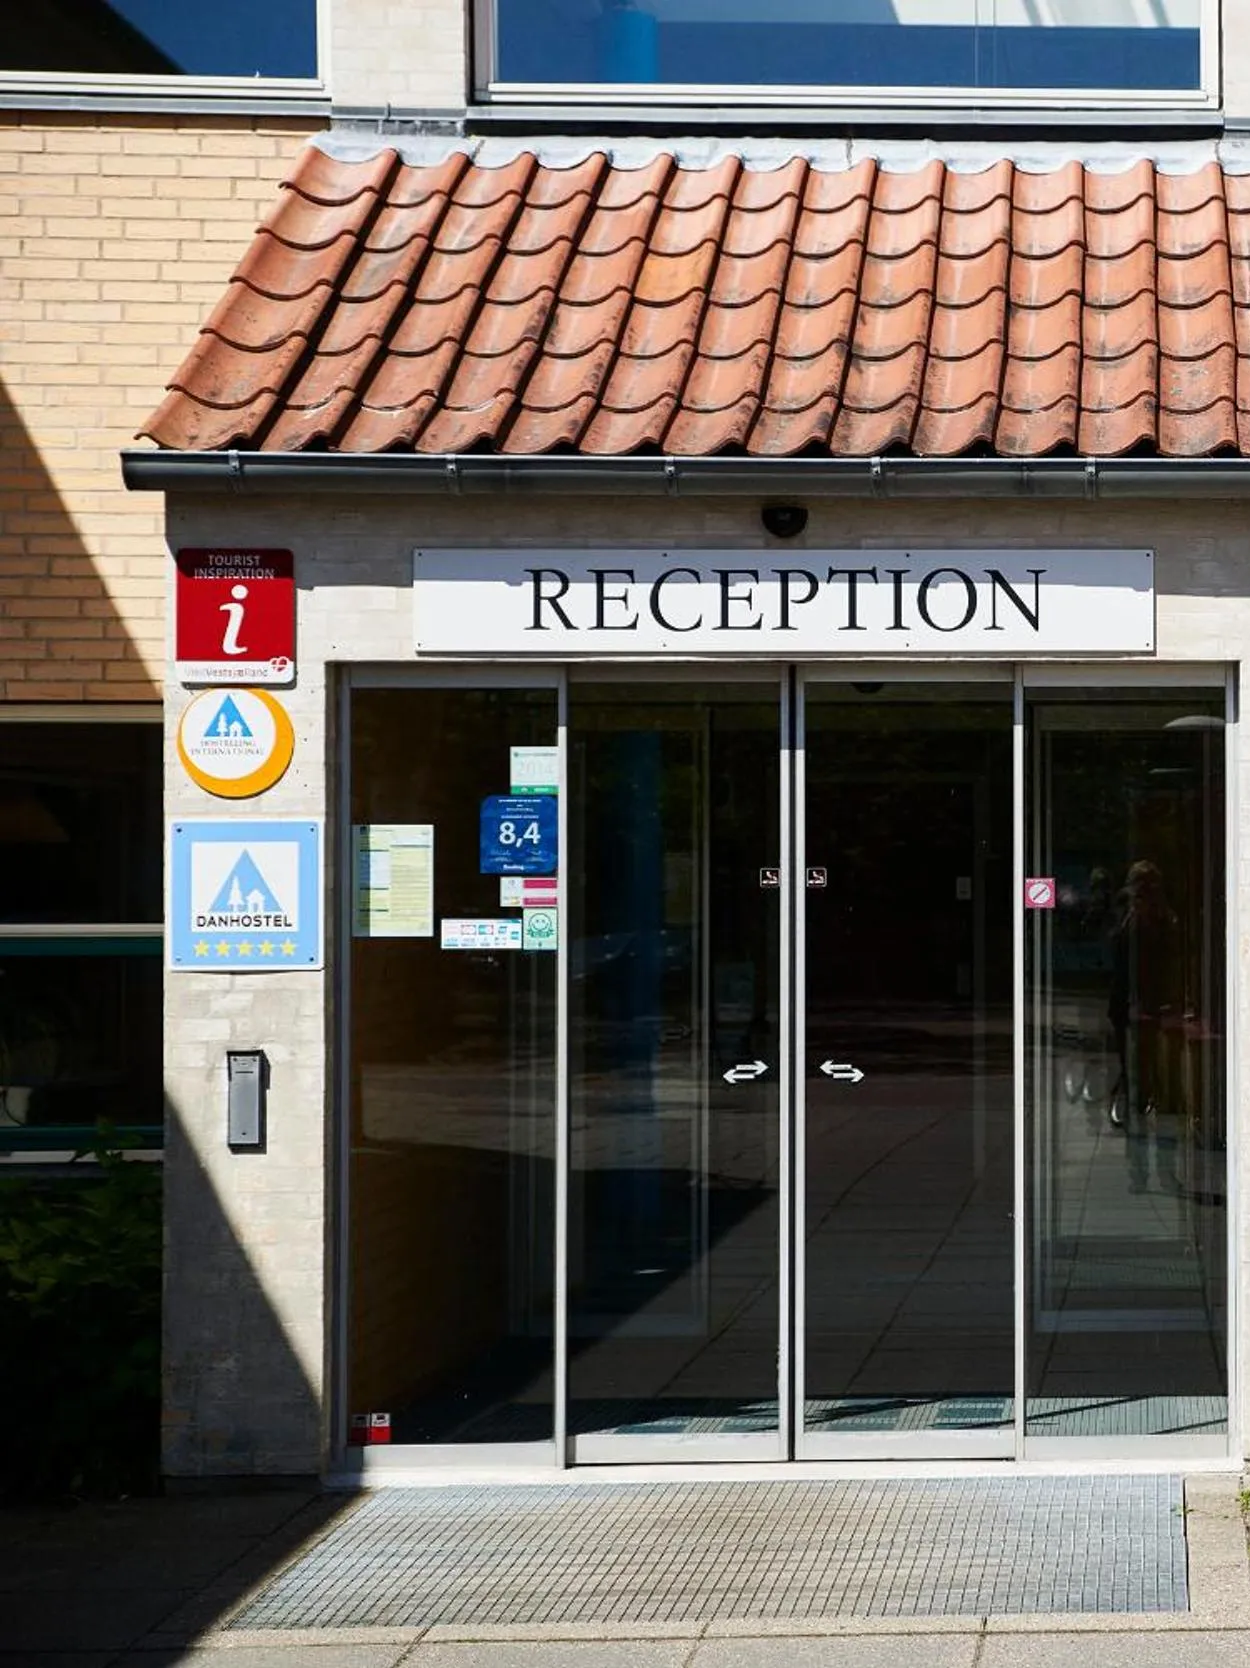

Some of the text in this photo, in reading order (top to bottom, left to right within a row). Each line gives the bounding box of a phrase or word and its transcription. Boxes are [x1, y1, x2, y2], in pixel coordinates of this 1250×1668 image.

[207, 554, 261, 566] TOURIST
[194, 567, 276, 580] INSPIRATION
[523, 567, 1048, 632] RECEPTION
[191, 747, 264, 757] INTERNATIONAL
[498, 821, 542, 848] 8,4
[196, 914, 293, 928] DANHOSTEL
